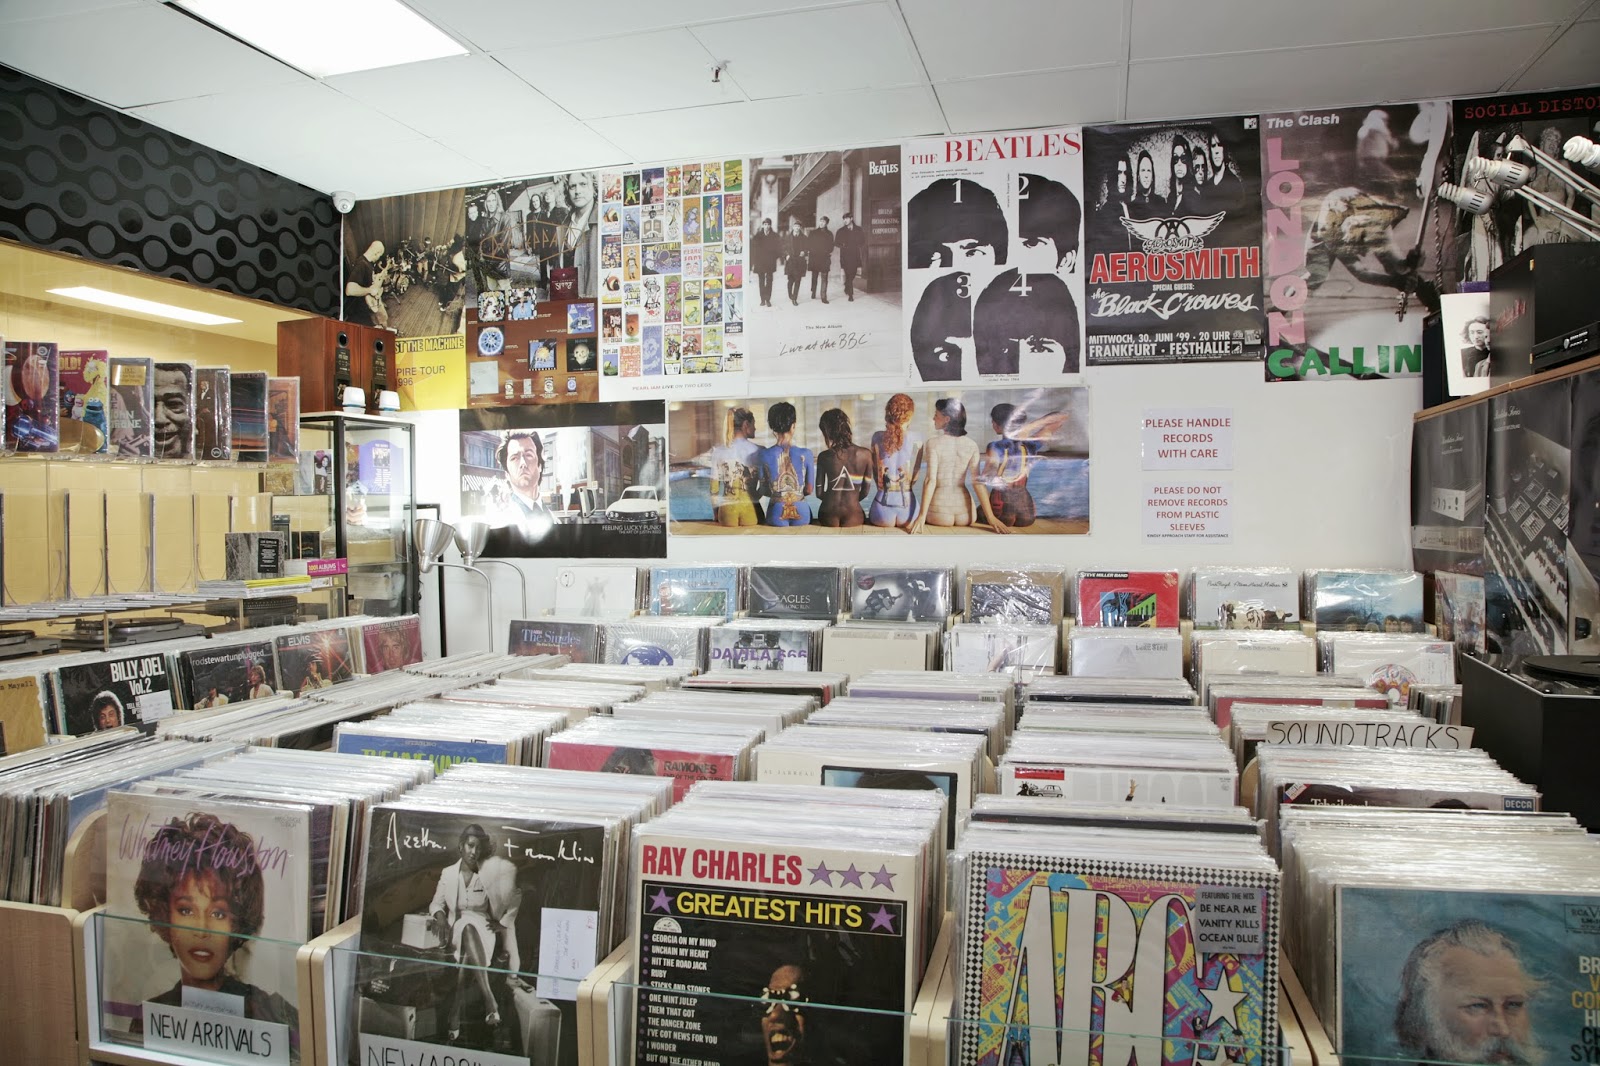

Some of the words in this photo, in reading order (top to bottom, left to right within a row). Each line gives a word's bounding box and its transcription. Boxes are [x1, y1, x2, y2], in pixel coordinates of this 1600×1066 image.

[1464, 102, 1532, 119] SOCIAL
[1538, 96, 1600, 113] DISTO
[1266, 117, 1293, 129] The
[1298, 114, 1340, 127] Clash
[909, 153, 938, 165] THE
[944, 132, 1082, 163] BEATLES
[869, 161, 899, 176] BEATLES
[952, 180, 963, 203] 1
[1018, 175, 1030, 200] 2
[1266, 137, 1308, 347] LONDON
[1089, 246, 1260, 284] AEROSMITH
[956, 275, 972, 299] 3
[1008, 273, 1032, 297] 4
[1152, 284, 1173, 292] SPECIAL
[1091, 288, 1110, 300] the
[1090, 292, 1164, 318] Black
[1158, 292, 1259, 320] Crowes
[407, 339, 424, 352] THE
[425, 336, 464, 351] MACHINE
[804, 340, 818, 351] at
[820, 339, 836, 350] the
[1089, 333, 1135, 345] MITTWOCH,
[1138, 334, 1151, 343] 30.
[1154, 333, 1173, 342] JUNI
[1199, 332, 1210, 341] 20
[1212, 331, 1230, 341] UHR
[1089, 343, 1157, 357] FRANKFURT
[1169, 341, 1230, 355] FESTHALLE
[420, 366, 446, 375] TOUR
[1145, 419, 1183, 428] PLEASE
[1186, 418, 1231, 427] HANDLE
[1163, 433, 1213, 442] RECORDS
[1158, 449, 1187, 458] WITH
[1190, 449, 1218, 458] CARE
[1170, 523, 1205, 531] SLEEVES
[778, 594, 811, 603] EAGLES
[288, 637, 310, 647] ELVIS
[522, 629, 542, 642] The
[544, 630, 581, 645] Singles
[712, 648, 771, 661] DAVILA
[777, 650, 808, 659] 666
[110, 660, 139, 682] BILLY
[139, 657, 165, 678] JOEL
[8, 681, 33, 690] Mayall
[1270, 723, 1460, 750] SOUNDTRACKS
[664, 761, 718, 774] RAMONES
[1505, 799, 1533, 809] DECCA
[119, 813, 197, 880] Whitney
[194, 820, 289, 881] Houston
[642, 845, 687, 877] RAY
[693, 848, 802, 885] CHARLES
[1202, 892, 1230, 900] FEATURING
[1232, 892, 1242, 900] THE
[676, 891, 800, 922] GREATEST
[805, 901, 863, 928] HITS
[1200, 904, 1211, 912] BE
[1214, 904, 1240, 913] NEAR
[1242, 905, 1257, 913] ME
[1198, 919, 1233, 928] VANITY
[1236, 920, 1259, 928] KILLS
[652, 934, 678, 944] GEORGIA
[679, 936, 687, 945] ON
[688, 937, 698, 946] MY
[699, 938, 716, 948] MIND
[1199, 933, 1233, 942] OCEAN
[1237, 934, 1258, 943] BLUE
[652, 945, 678, 956] UNCHAIN
[679, 948, 688, 956] MY
[689, 948, 709, 959] HEART
[651, 957, 662, 966] HIT
[663, 958, 674, 967] THE
[676, 959, 692, 969] ROAD
[692, 961, 707, 970] JACK
[651, 969, 667, 978] RUBY
[651, 981, 672, 989] STICKS
[687, 984, 711, 994] STONES
[649, 993, 661, 1002] ONE
[662, 994, 678, 1004] MINT
[679, 996, 697, 1006] JULEP
[648, 1005, 665, 1015] THEM
[666, 1006, 681, 1016] THAT
[682, 1009, 695, 1018] GOT
[648, 1017, 659, 1026] THE
[660, 1018, 684, 1029] DANGER
[685, 1021, 701, 1031] ZONE
[150, 1013, 188, 1040] NEW
[192, 1021, 271, 1057] ARRIVALS
[647, 1028, 658, 1037] I'VE
[660, 1030, 672, 1038] GOT
[673, 1032, 690, 1041] NEWS
[691, 1033, 704, 1043] FOR
[704, 1035, 718, 1045] YOU
[651, 1041, 677, 1052] WONDER
[646, 1053, 659, 1062] BUT
[659, 1055, 668, 1064] ON
[669, 1056, 681, 1064] THE
